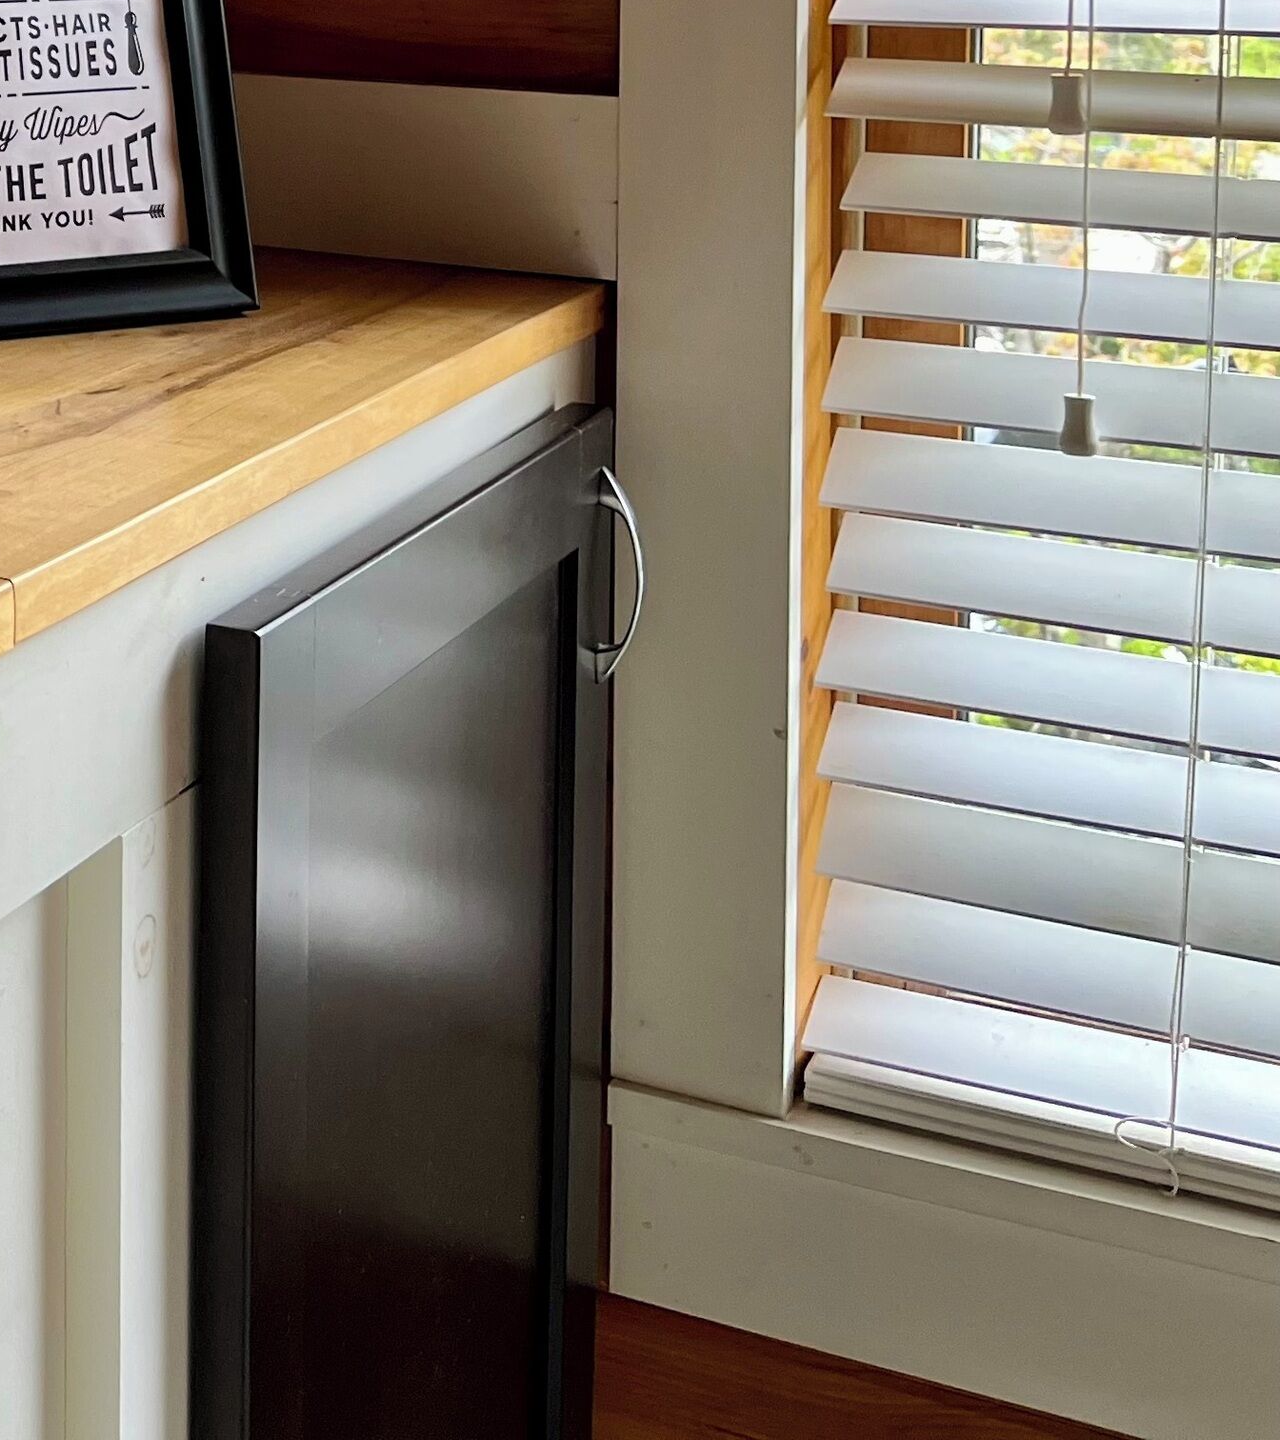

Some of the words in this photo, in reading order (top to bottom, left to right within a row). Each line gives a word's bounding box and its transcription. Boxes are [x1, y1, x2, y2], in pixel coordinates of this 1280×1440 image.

[23, 106, 102, 140] Wipes
[57, 122, 158, 195] TOILET
[42, 209, 95, 230] YOU!
